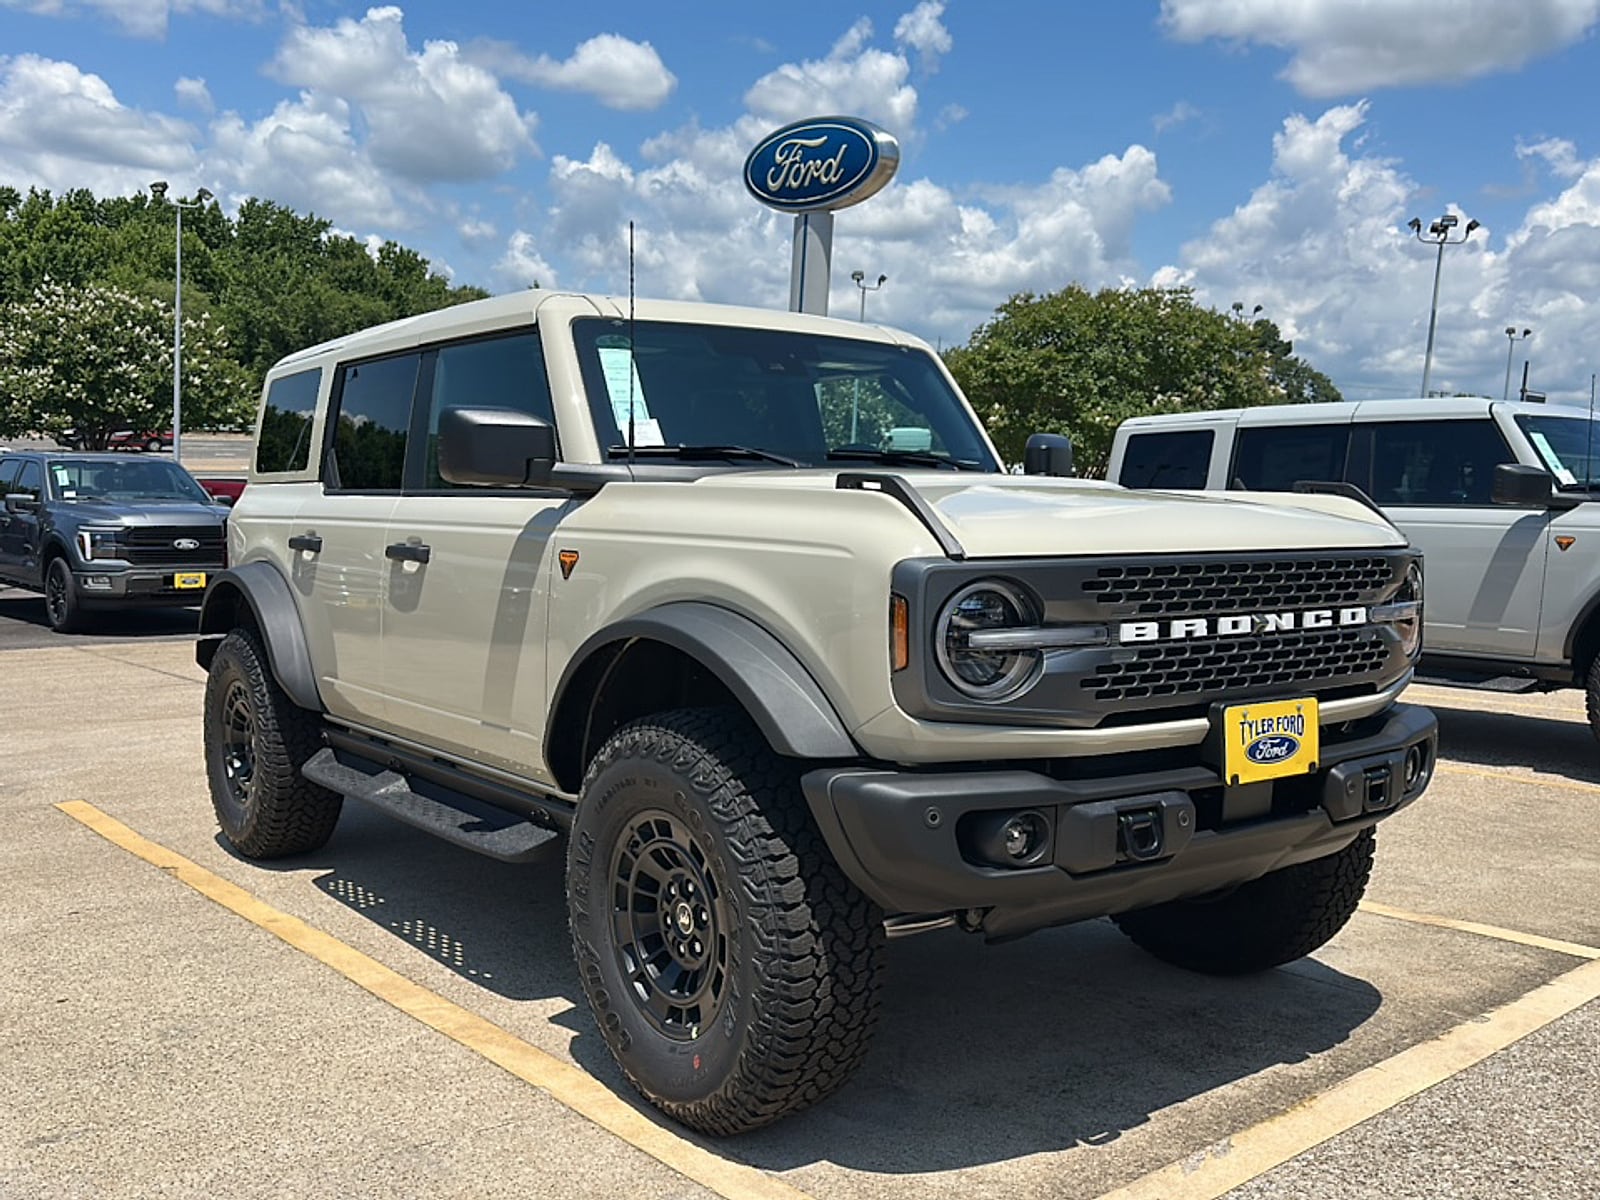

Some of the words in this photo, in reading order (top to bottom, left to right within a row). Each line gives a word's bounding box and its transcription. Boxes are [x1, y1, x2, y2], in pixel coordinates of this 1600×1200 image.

[767, 136, 848, 191] Ford
[1119, 606, 1368, 643] BRONCO
[1239, 719, 1274, 746] TYLER
[1277, 714, 1304, 736] FORD
[1255, 738, 1290, 760] Ford
